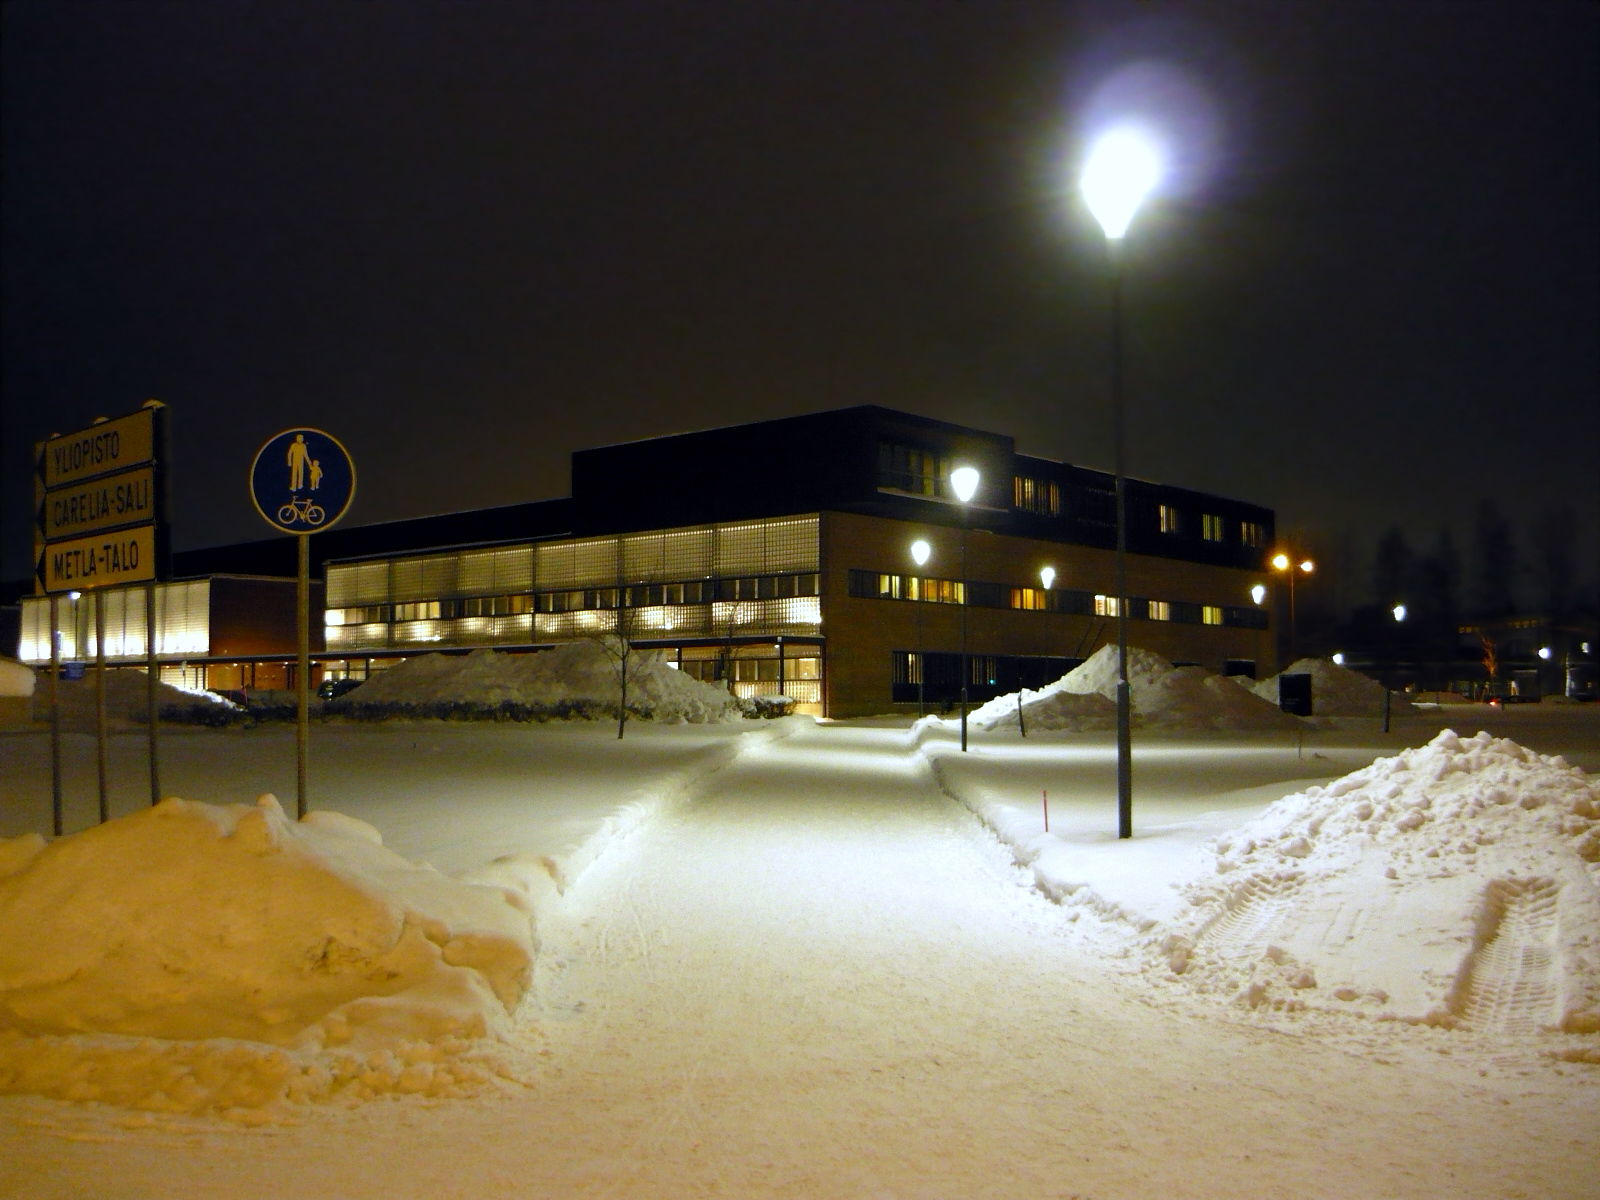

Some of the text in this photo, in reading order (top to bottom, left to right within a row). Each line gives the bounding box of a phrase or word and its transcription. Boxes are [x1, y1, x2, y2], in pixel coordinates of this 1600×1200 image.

[54, 431, 120, 475] YLIOPISTO
[54, 479, 148, 527] CARELIA-SALI
[54, 541, 139, 580] METLA-TALO
